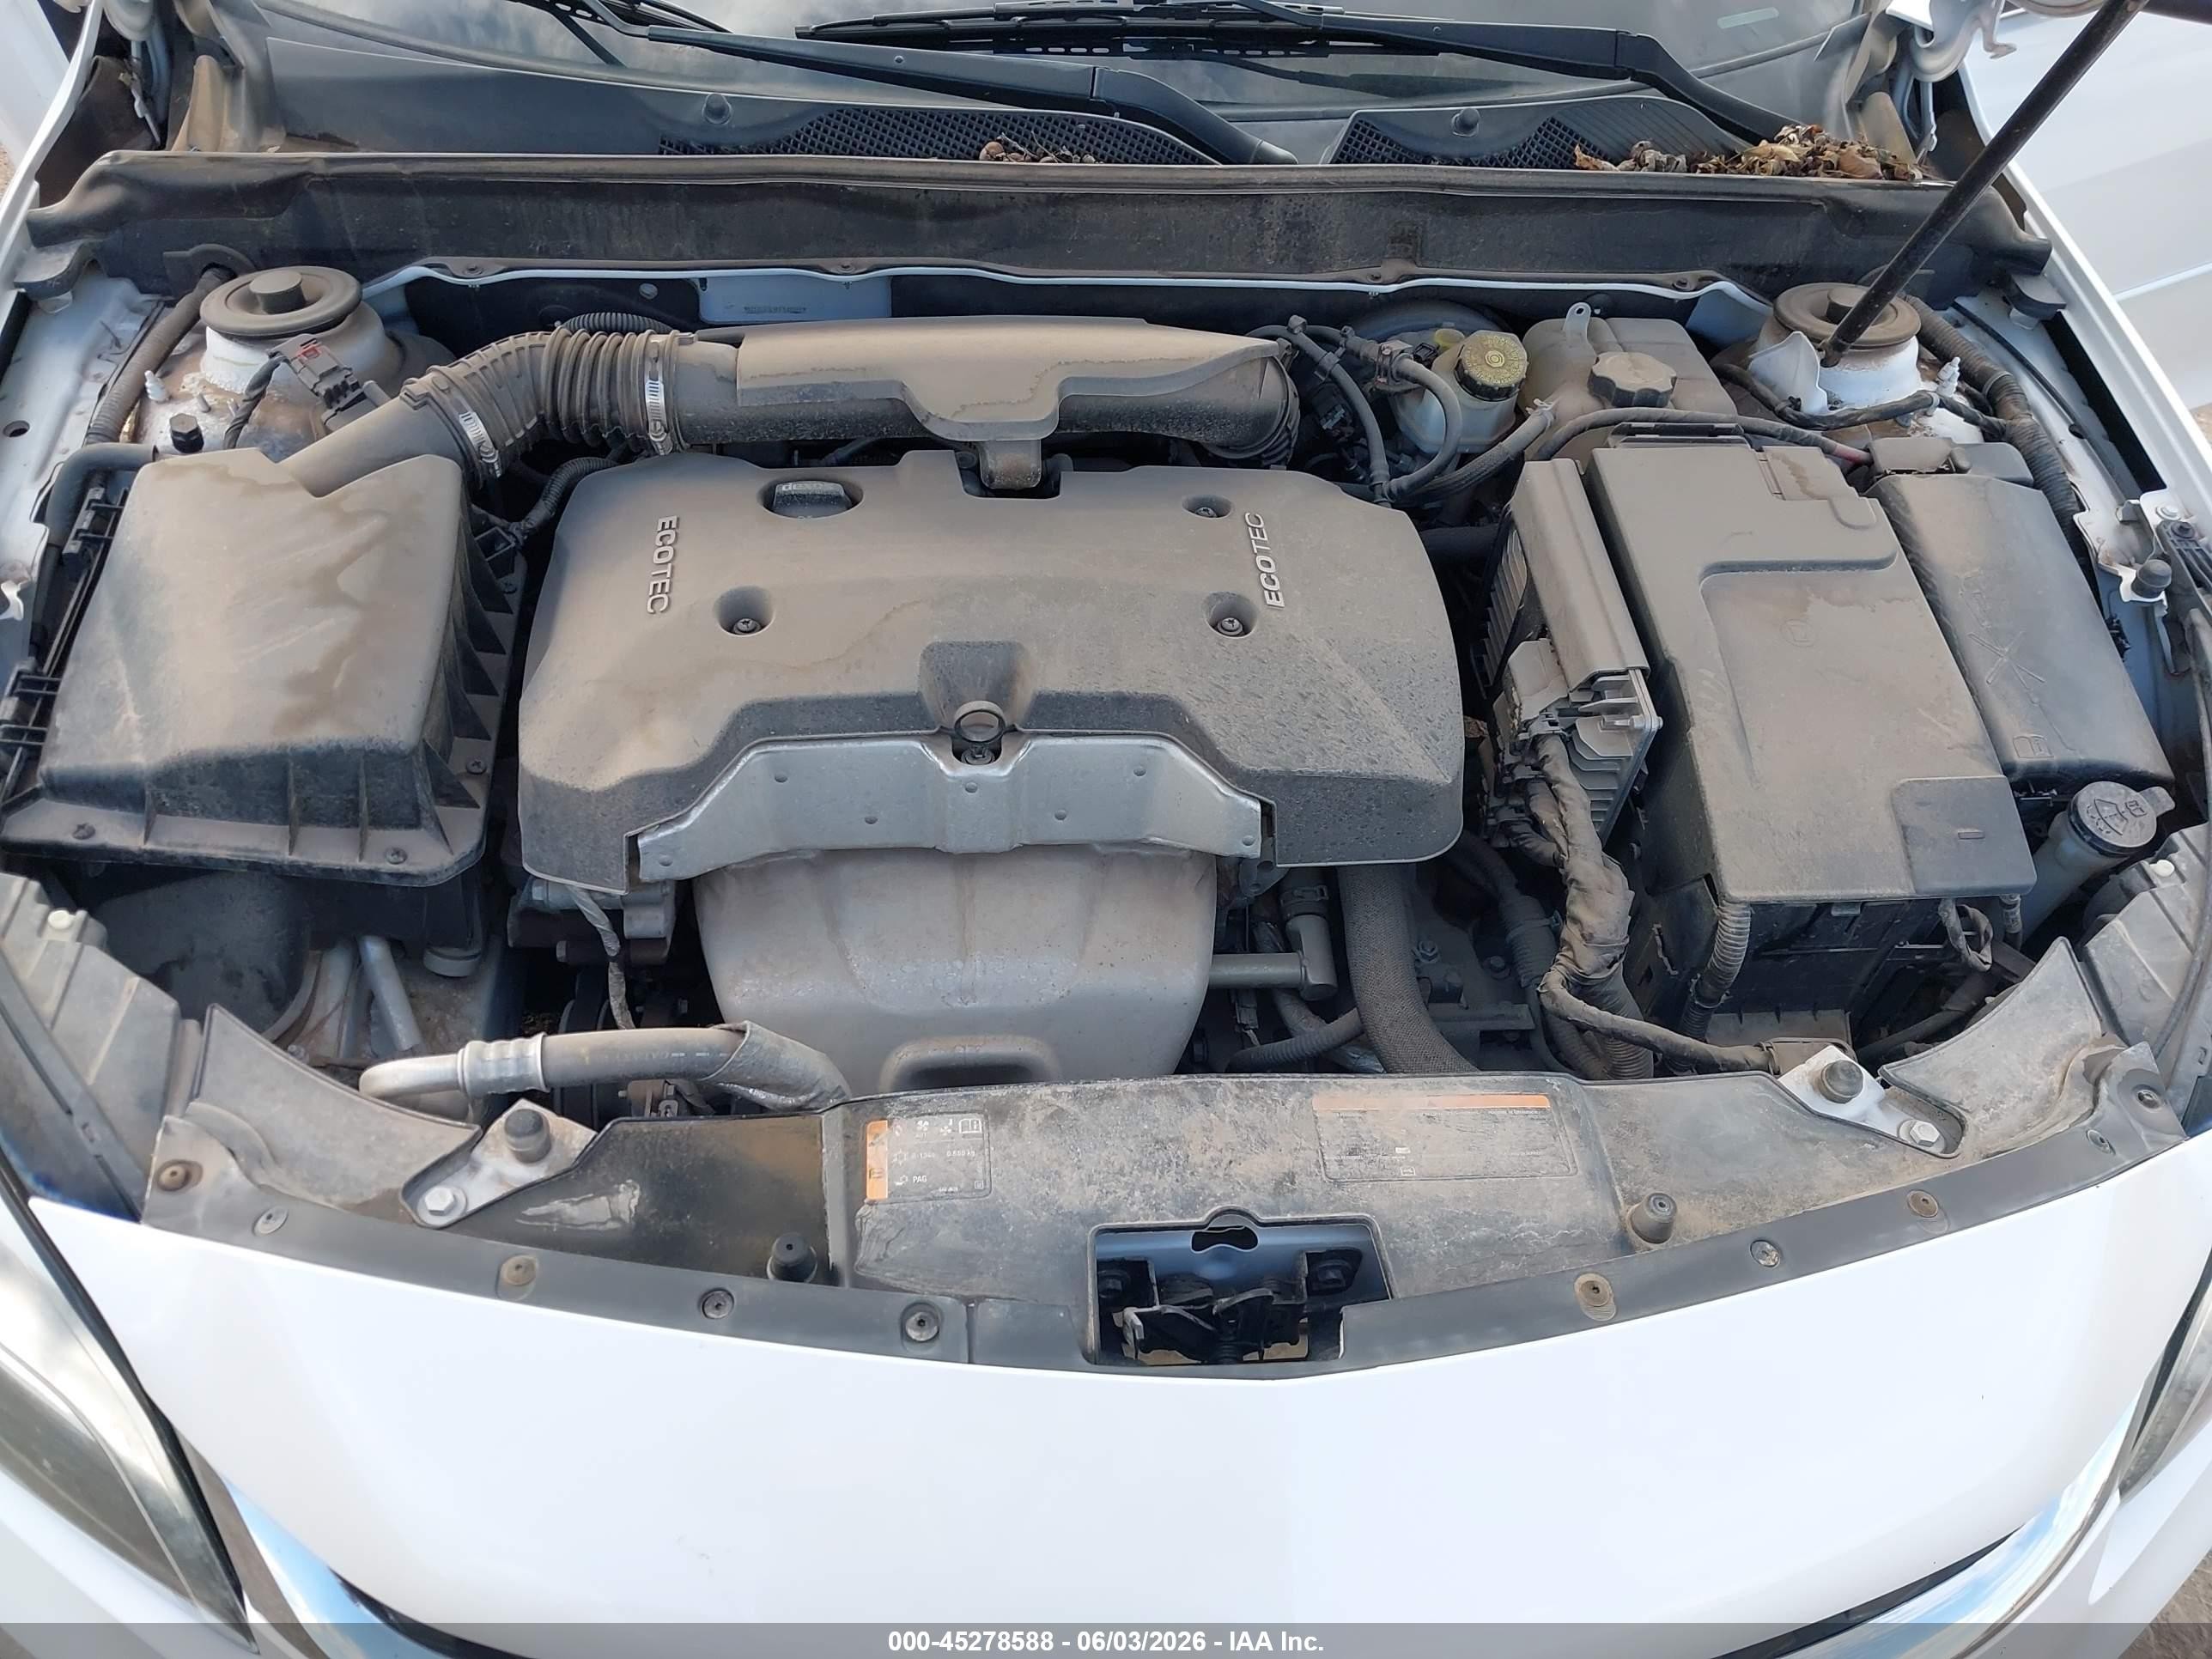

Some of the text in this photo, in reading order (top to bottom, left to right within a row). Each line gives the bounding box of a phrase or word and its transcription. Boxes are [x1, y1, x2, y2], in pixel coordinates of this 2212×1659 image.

[646, 514, 680, 616] ECOTEC
[1243, 512, 1285, 608] ECOTEC
[913, 1175, 927, 1183] PAG
